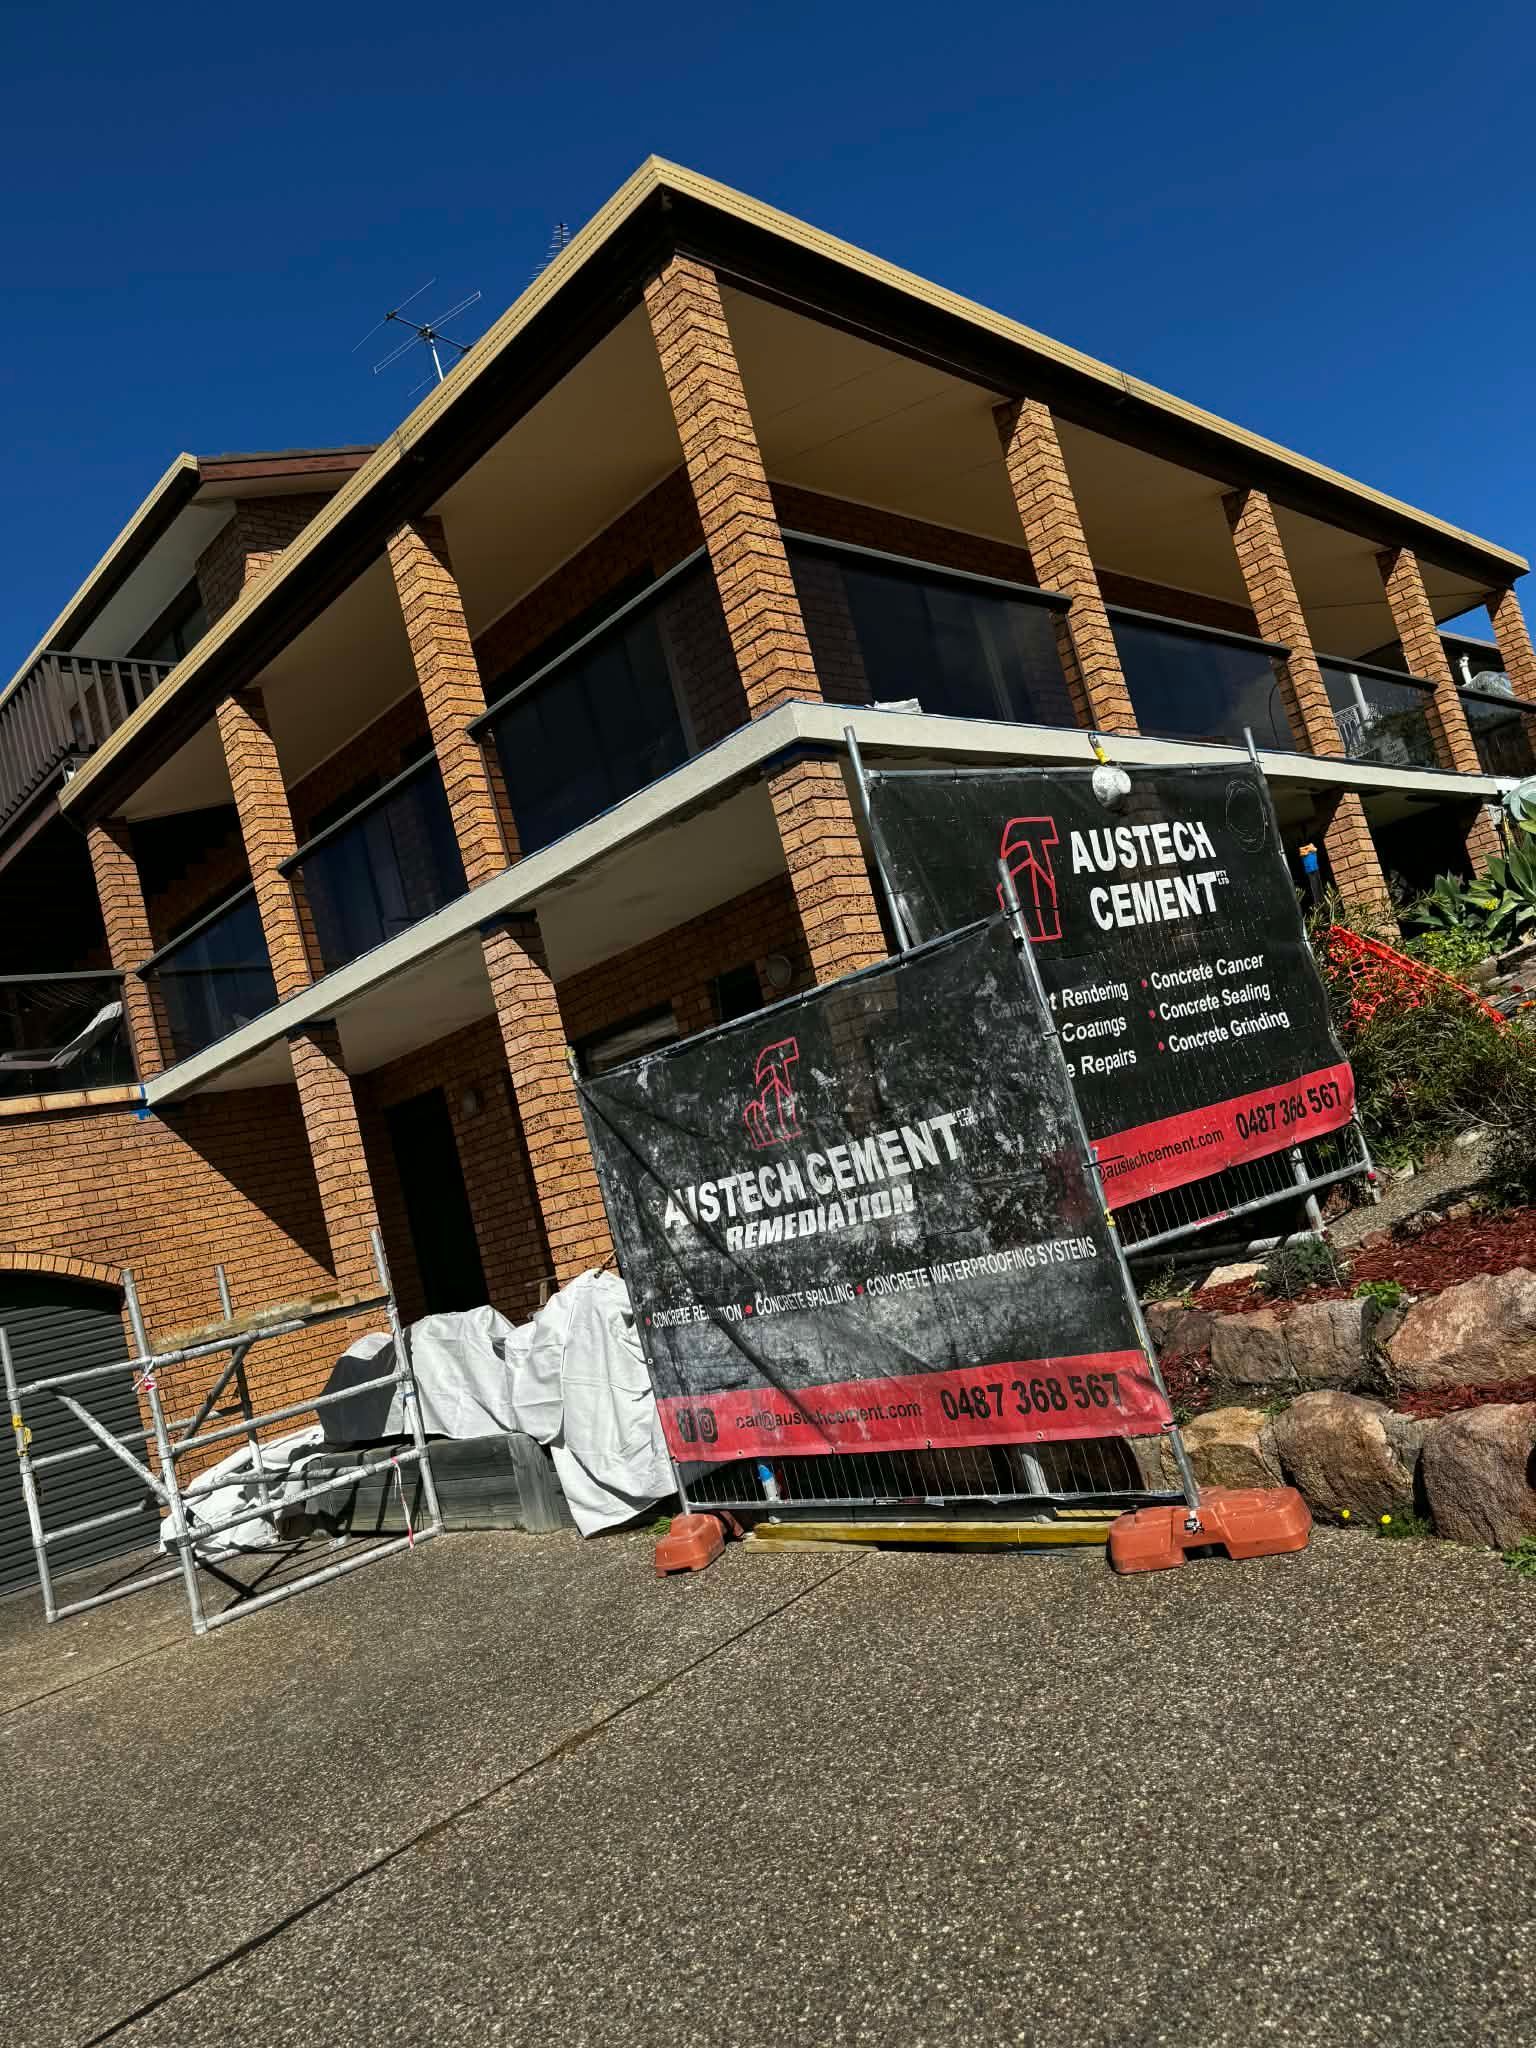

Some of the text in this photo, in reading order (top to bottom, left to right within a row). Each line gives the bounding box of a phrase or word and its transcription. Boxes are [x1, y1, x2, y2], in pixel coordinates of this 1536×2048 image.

[1071, 822, 1216, 874] AUSTECH
[1090, 872, 1217, 931] CEMENT
[1062, 980, 1129, 1008] Rendering
[1151, 954, 1264, 990] Concrete Cancer
[1159, 983, 1271, 1021] Concrete Sealing
[1062, 1016, 1127, 1042] Coatings
[1168, 1011, 1290, 1053] Concrete Grinding
[1081, 1049, 1137, 1075] Repairs
[1235, 1102, 1277, 1140] 0487
[1279, 1093, 1308, 1126] 368
[1307, 1081, 1342, 1114] 567
[664, 1112, 961, 1229] AUSTECH CEMENT
[726, 1183, 917, 1252] REMEDIATION
[652, 1306, 692, 1328] CONCRETE
[755, 1292, 804, 1316] CONCRETE
[805, 1283, 855, 1308] SPALLING
[866, 1267, 928, 1297] CONCRETE
[929, 1247, 1035, 1284] WATERPROOFING
[1036, 1235, 1097, 1265] SYSTEMS
[940, 1383, 1004, 1420] 0487
[1011, 1377, 1068, 1415] 368
[1067, 1373, 1122, 1408] 567
